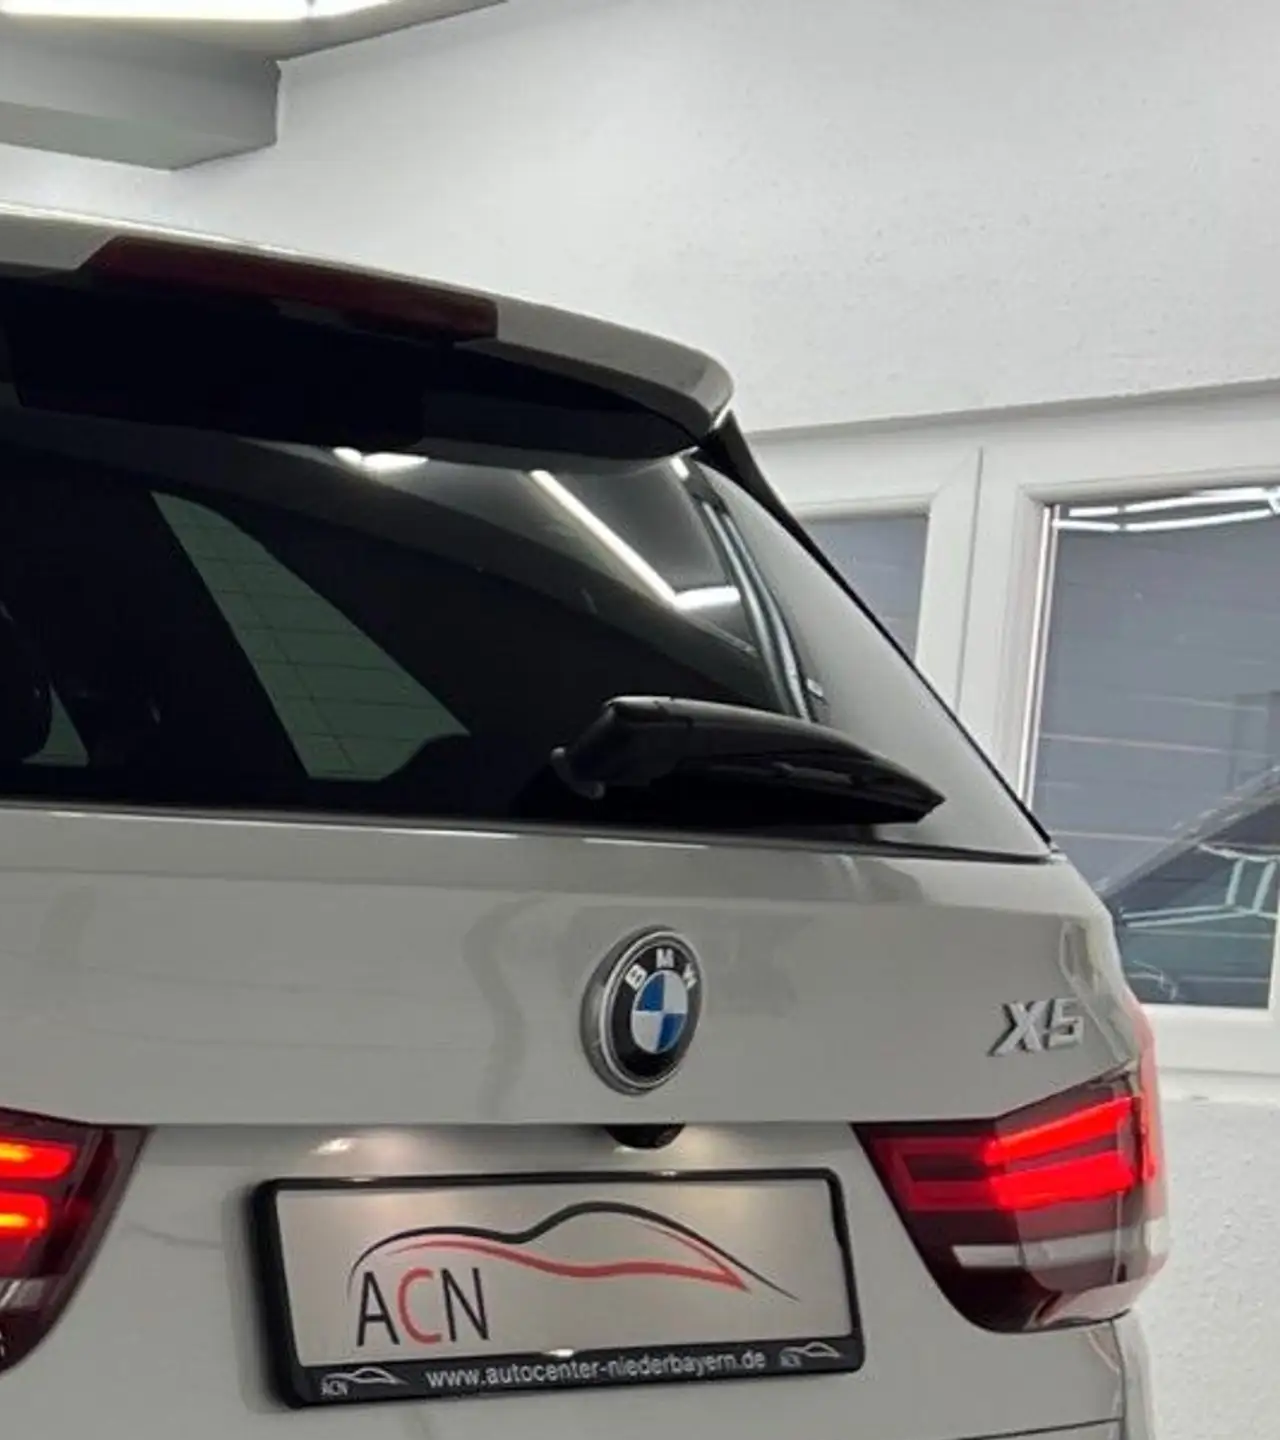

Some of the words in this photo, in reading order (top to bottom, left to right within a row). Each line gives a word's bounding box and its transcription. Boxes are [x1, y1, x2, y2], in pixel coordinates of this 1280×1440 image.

[625, 948, 698, 990] BMW
[987, 999, 1085, 1057] X5
[356, 1267, 490, 1347] ACN
[425, 1351, 766, 1388] www.autocenter-niederbayern.de
